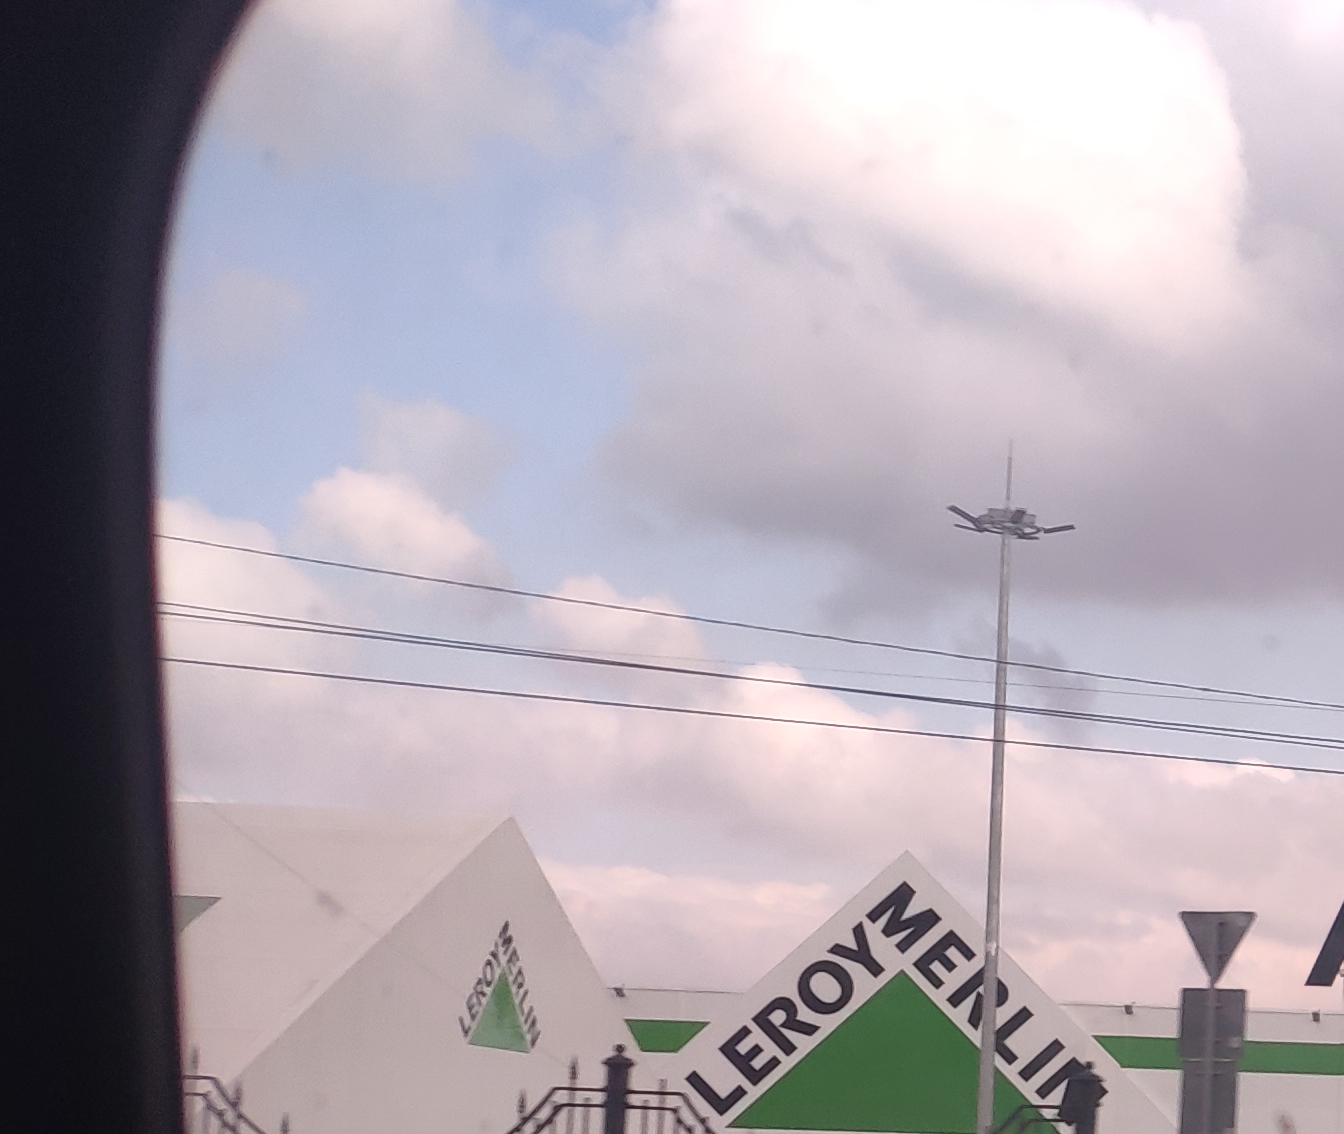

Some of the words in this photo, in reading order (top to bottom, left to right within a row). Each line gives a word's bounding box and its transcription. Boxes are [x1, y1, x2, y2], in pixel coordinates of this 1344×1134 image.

[458, 941, 502, 1038] LEROY
[498, 919, 542, 1049] MERLIN
[684, 921, 886, 1117] LEROY
